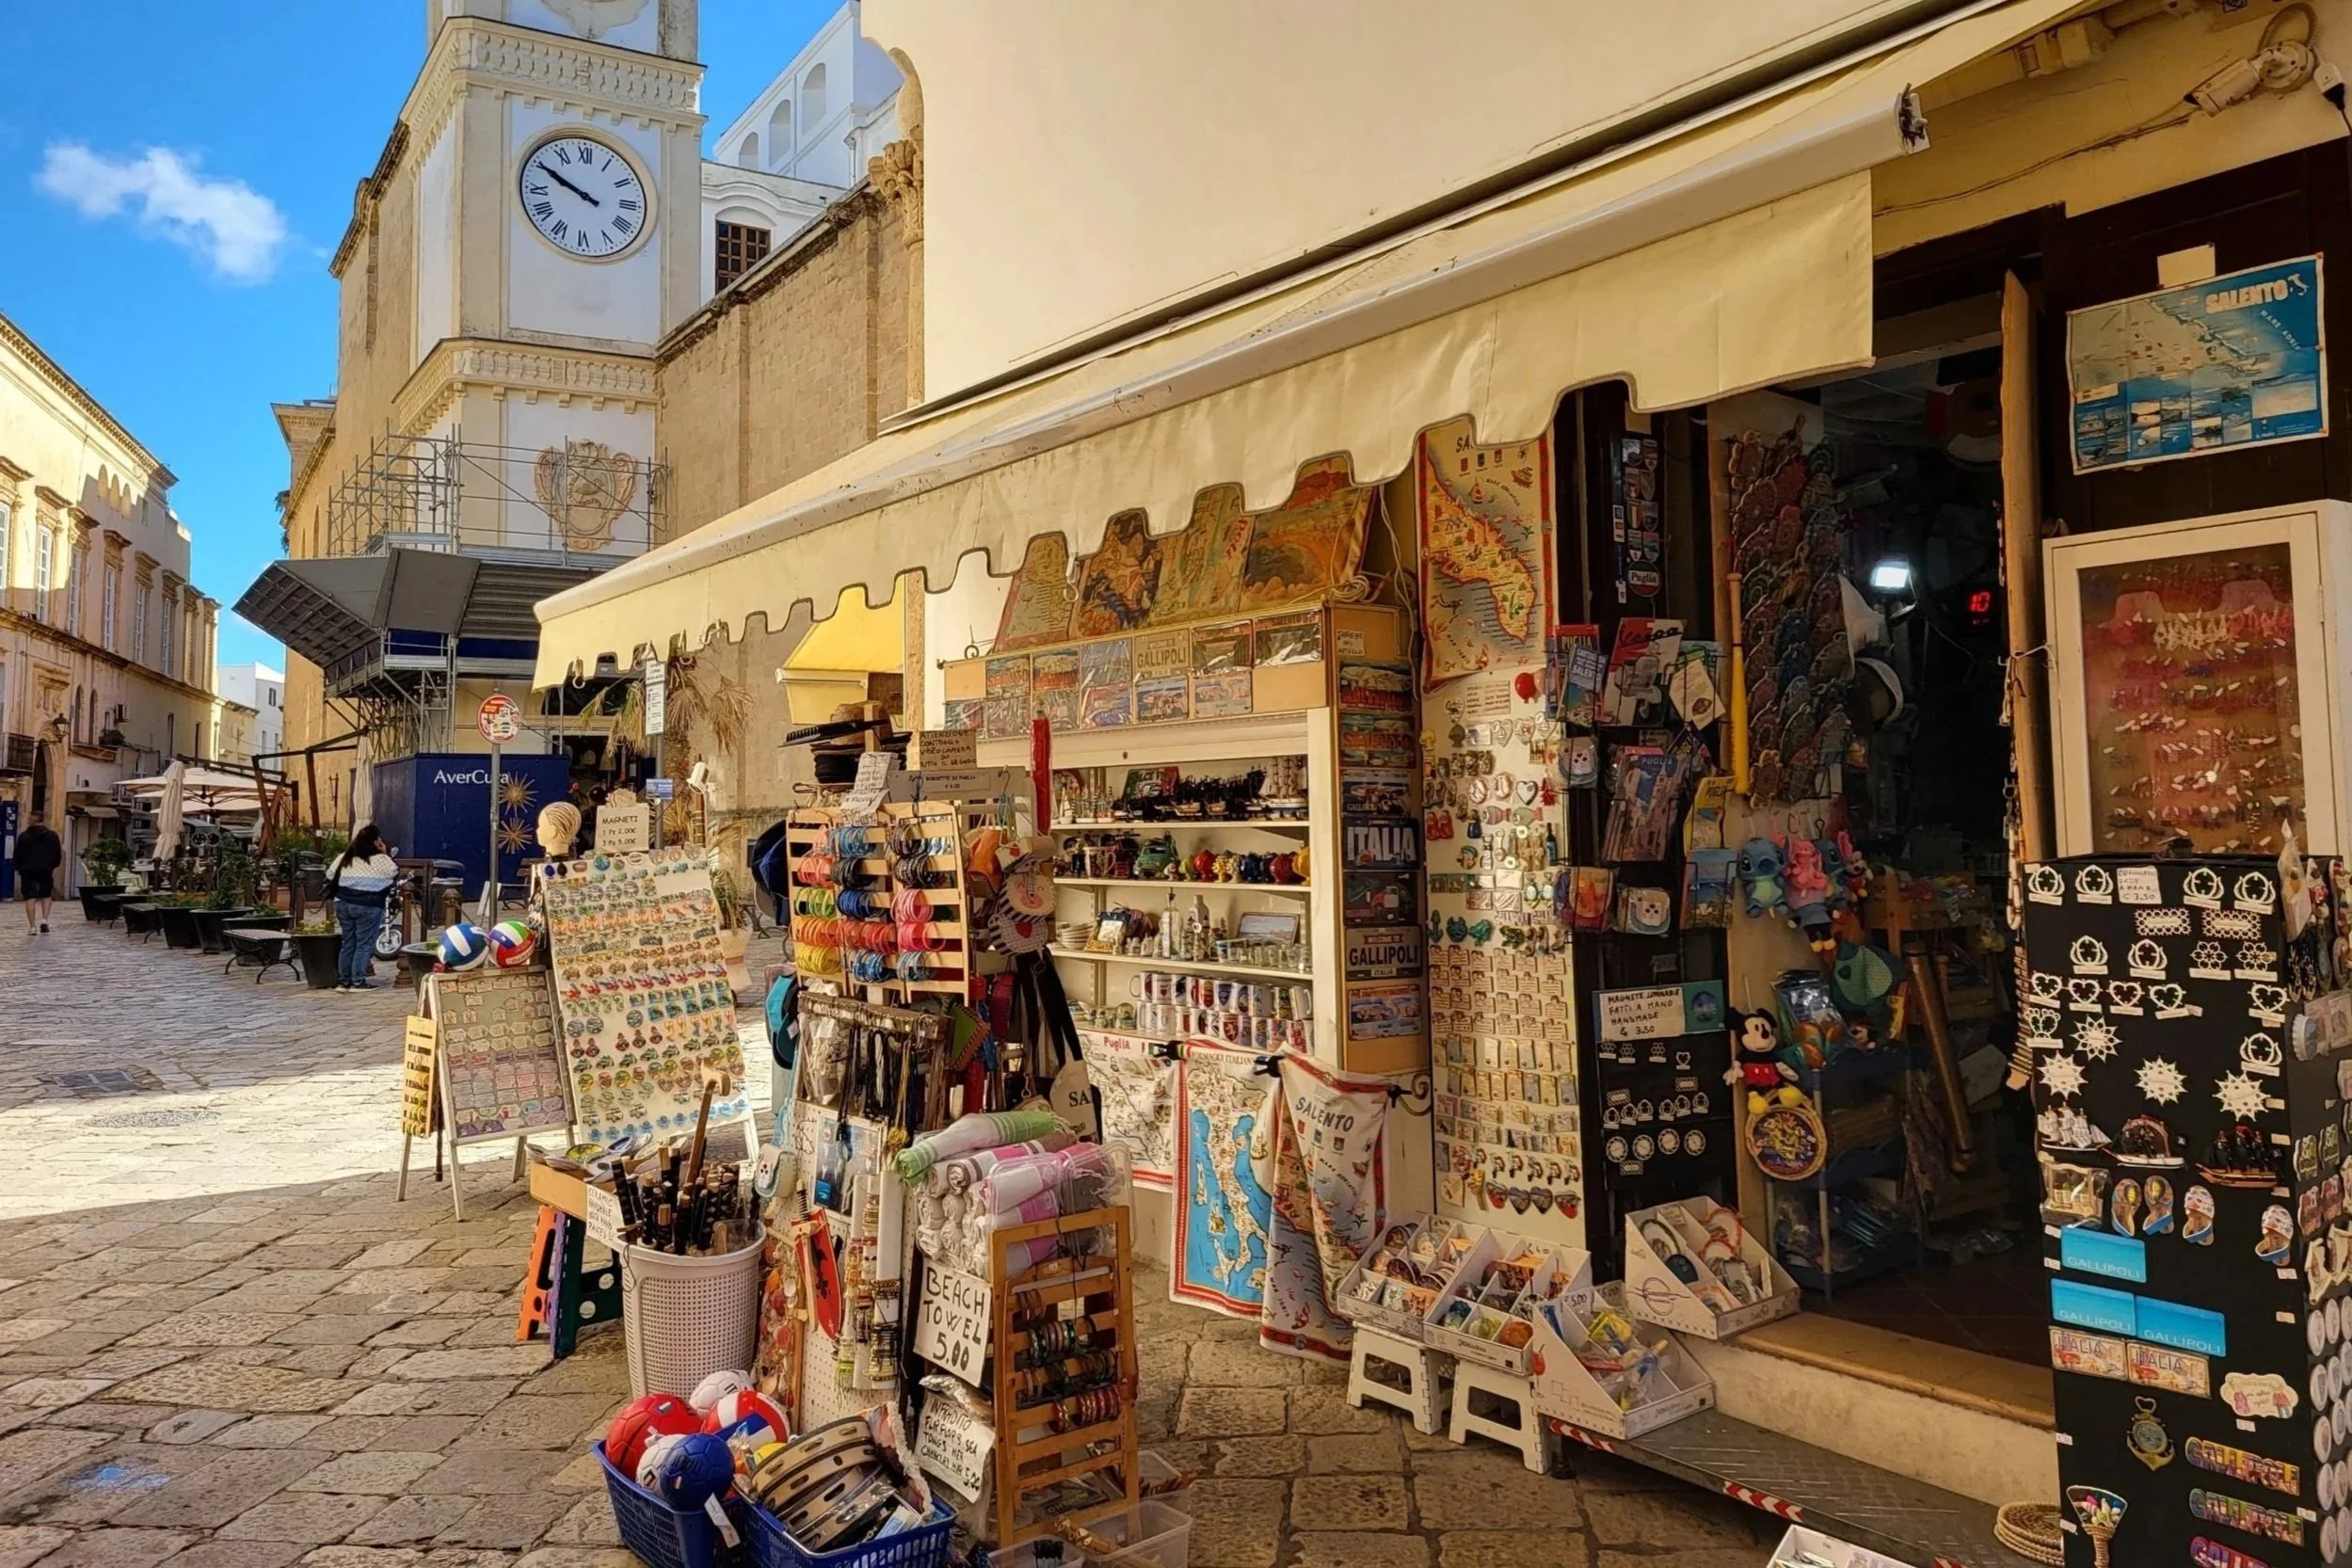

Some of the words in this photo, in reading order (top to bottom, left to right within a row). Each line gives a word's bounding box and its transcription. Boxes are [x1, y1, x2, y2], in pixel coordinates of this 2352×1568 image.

[2206, 279, 2288, 314] SALENTO
[1456, 434, 1474, 454] SA
[1137, 647, 1186, 668] GALLIPOLI
[1641, 757, 1672, 765] PUGLIA
[434, 769, 509, 784] AverCua
[602, 815, 638, 824] MAGNETI
[1347, 826, 1416, 861] ITALIA
[2133, 892, 2155, 901] 3.50
[1349, 945, 1418, 966] GALLIPOLI
[1647, 1000, 1672, 1010] MANO
[1610, 1012, 1658, 1026] HANDMADE
[1635, 1025, 1655, 1035] 3.50
[1295, 1096, 1354, 1132] SALENTO
[2067, 1256, 2139, 1279] GALLIPOLI
[926, 1267, 985, 1319] BEACH
[1570, 1293, 1588, 1308] 5.00
[923, 1300, 982, 1346] TOWEL
[2058, 1309, 2131, 1332] GALLIPOLI
[933, 1331, 969, 1371] 5.00
[2057, 1336, 2104, 1355] ITALIA
[2144, 1329, 2221, 1353] GALLIPOLI
[2136, 1350, 2184, 1371] ITALIA
